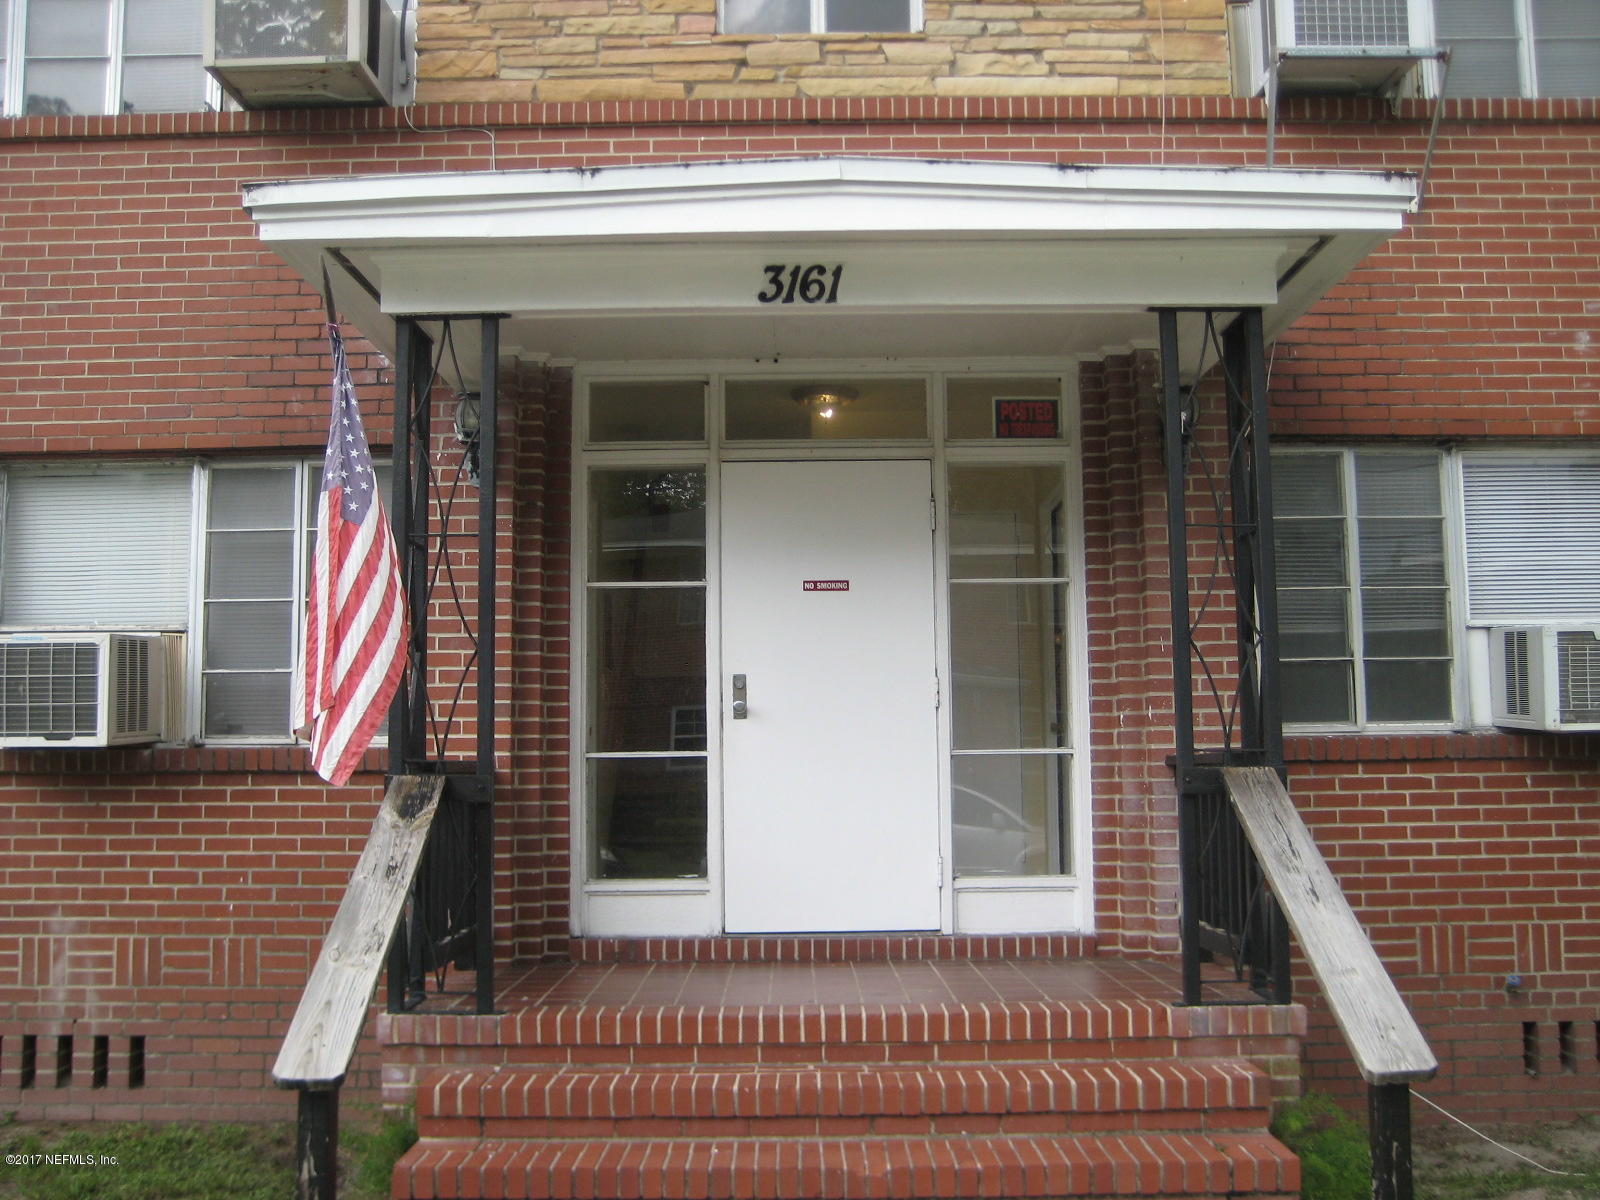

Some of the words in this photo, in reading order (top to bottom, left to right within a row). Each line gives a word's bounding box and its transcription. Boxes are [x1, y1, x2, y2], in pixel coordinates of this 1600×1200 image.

[758, 264, 843, 304] 3161
[1000, 402, 1054, 420] POSTED
[804, 582, 814, 590] NO
[816, 582, 848, 590] SMOKING
